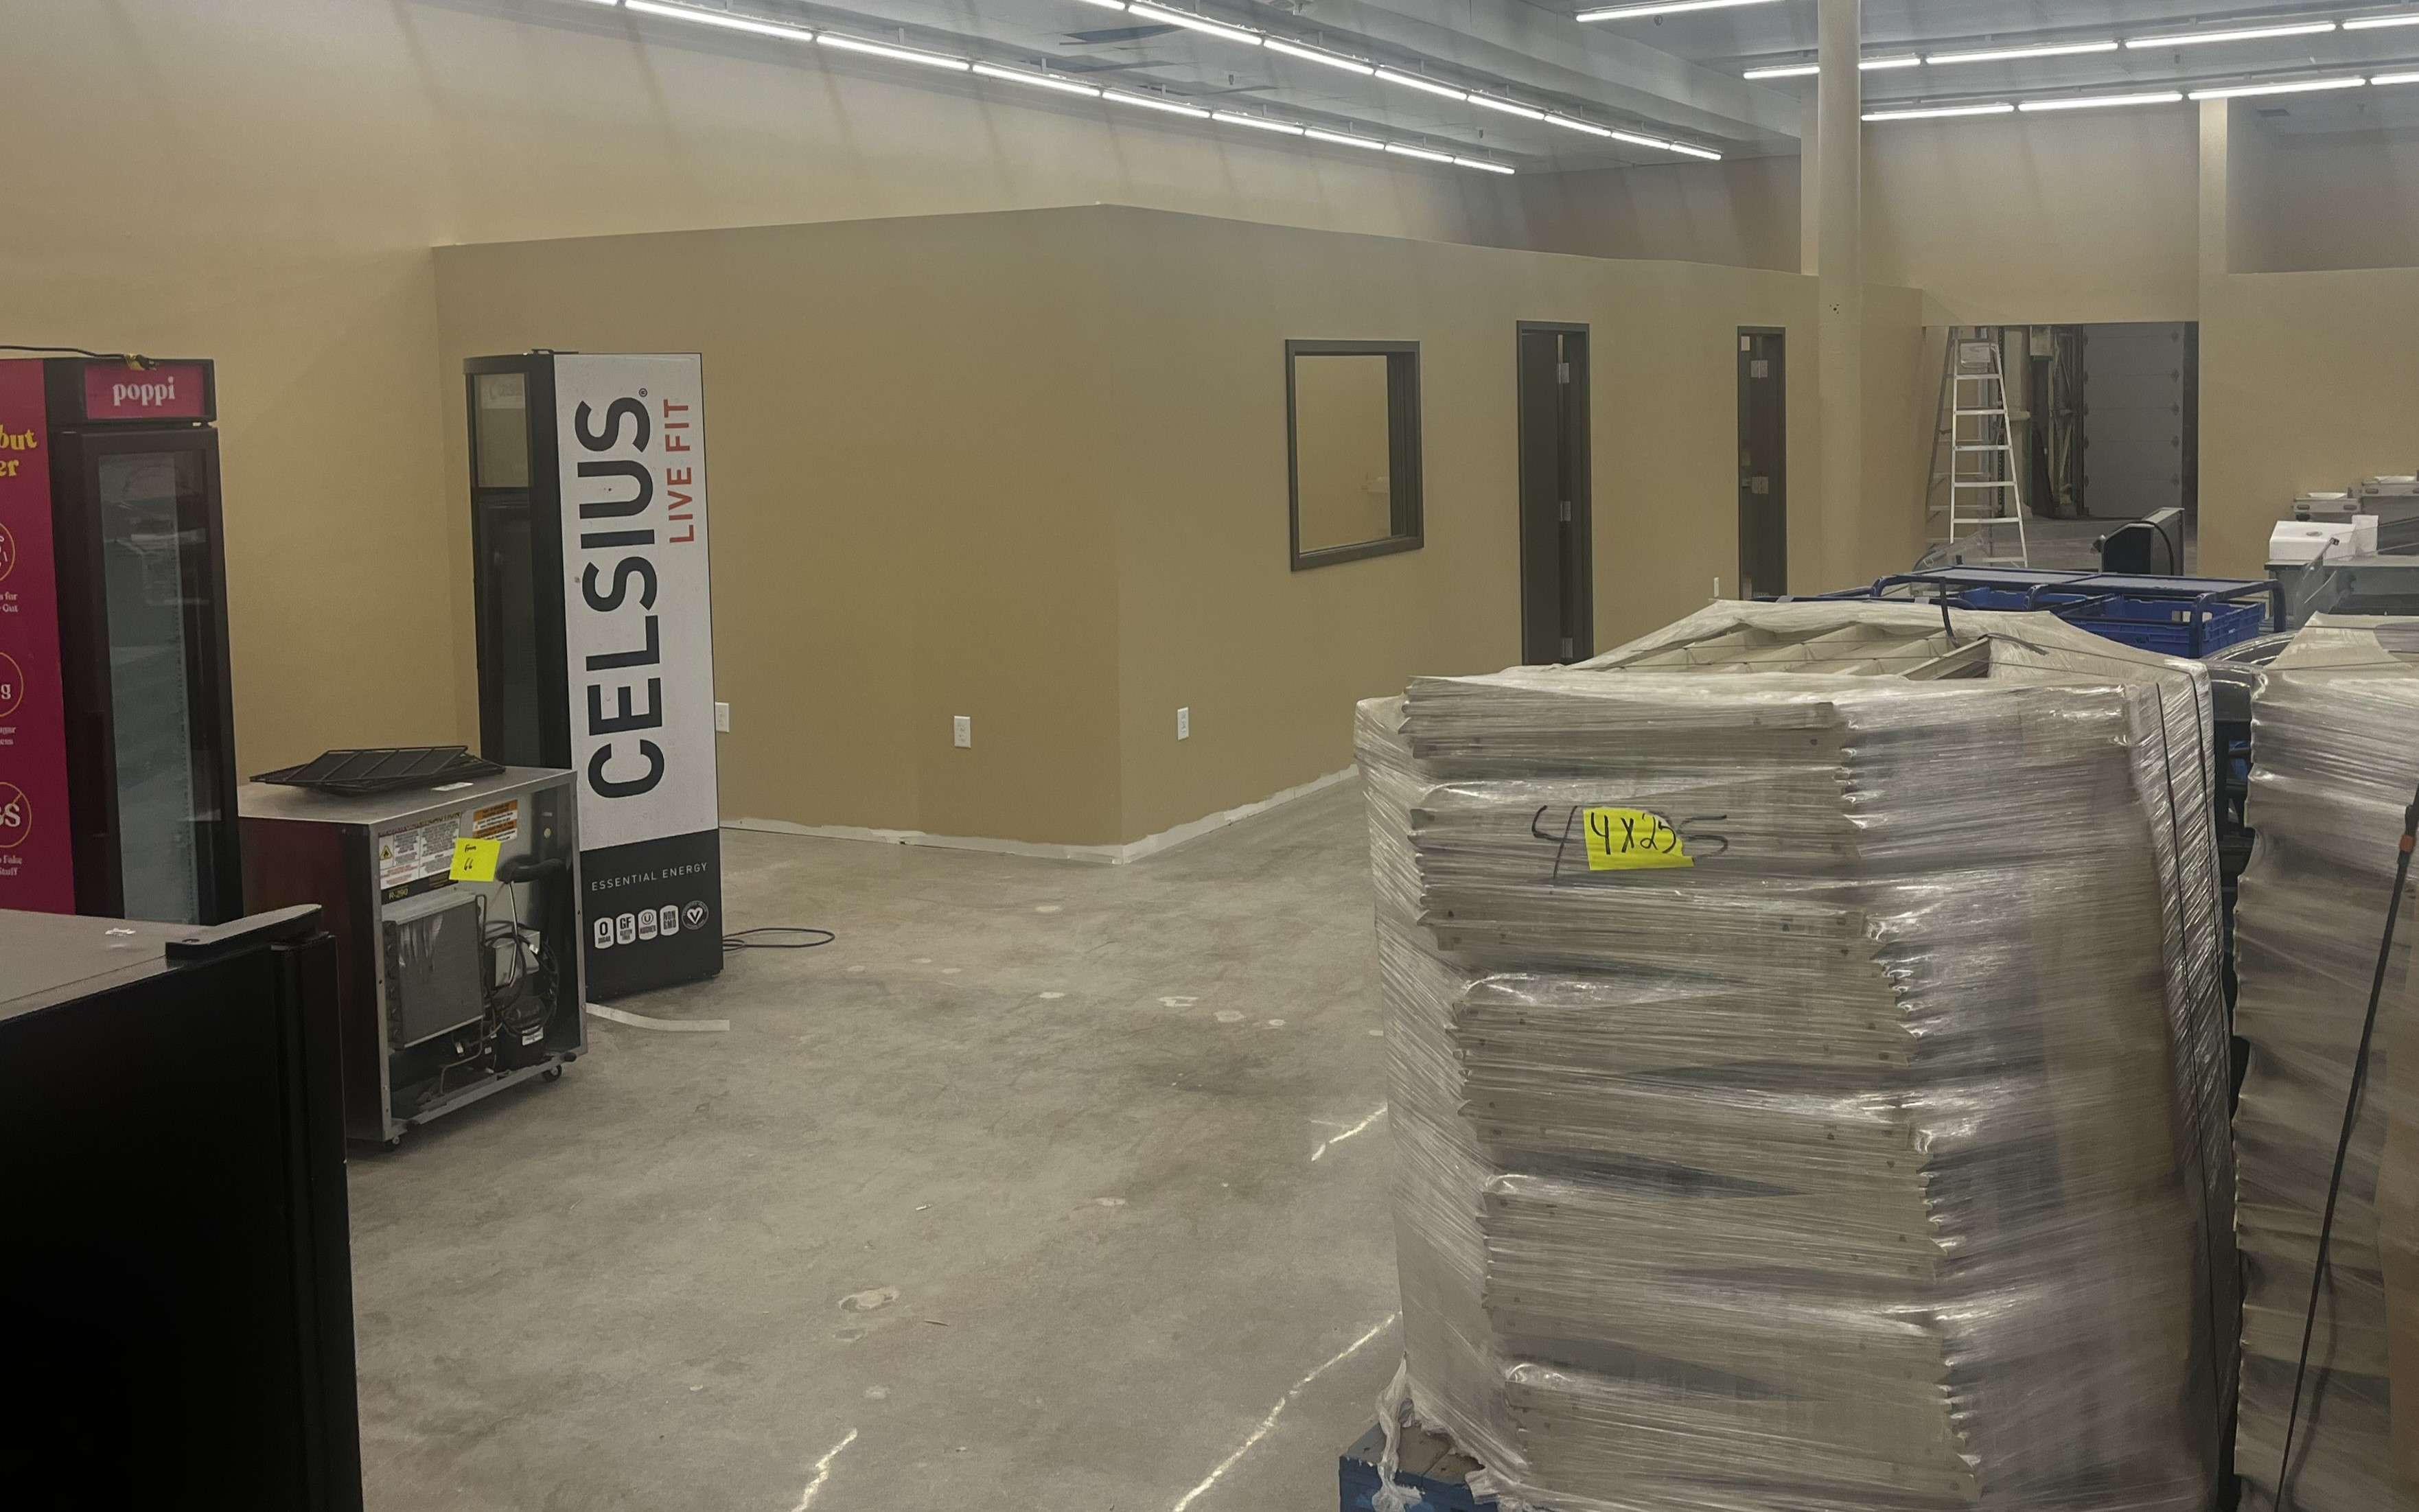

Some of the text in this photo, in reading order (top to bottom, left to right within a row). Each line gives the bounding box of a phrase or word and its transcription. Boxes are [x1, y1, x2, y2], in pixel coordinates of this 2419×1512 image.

[113, 376, 176, 406] poppi
[663, 399, 695, 544] LIVE FIT
[592, 862, 708, 891] ESSENTIAL ENERGY
[620, 916, 632, 929] GF
